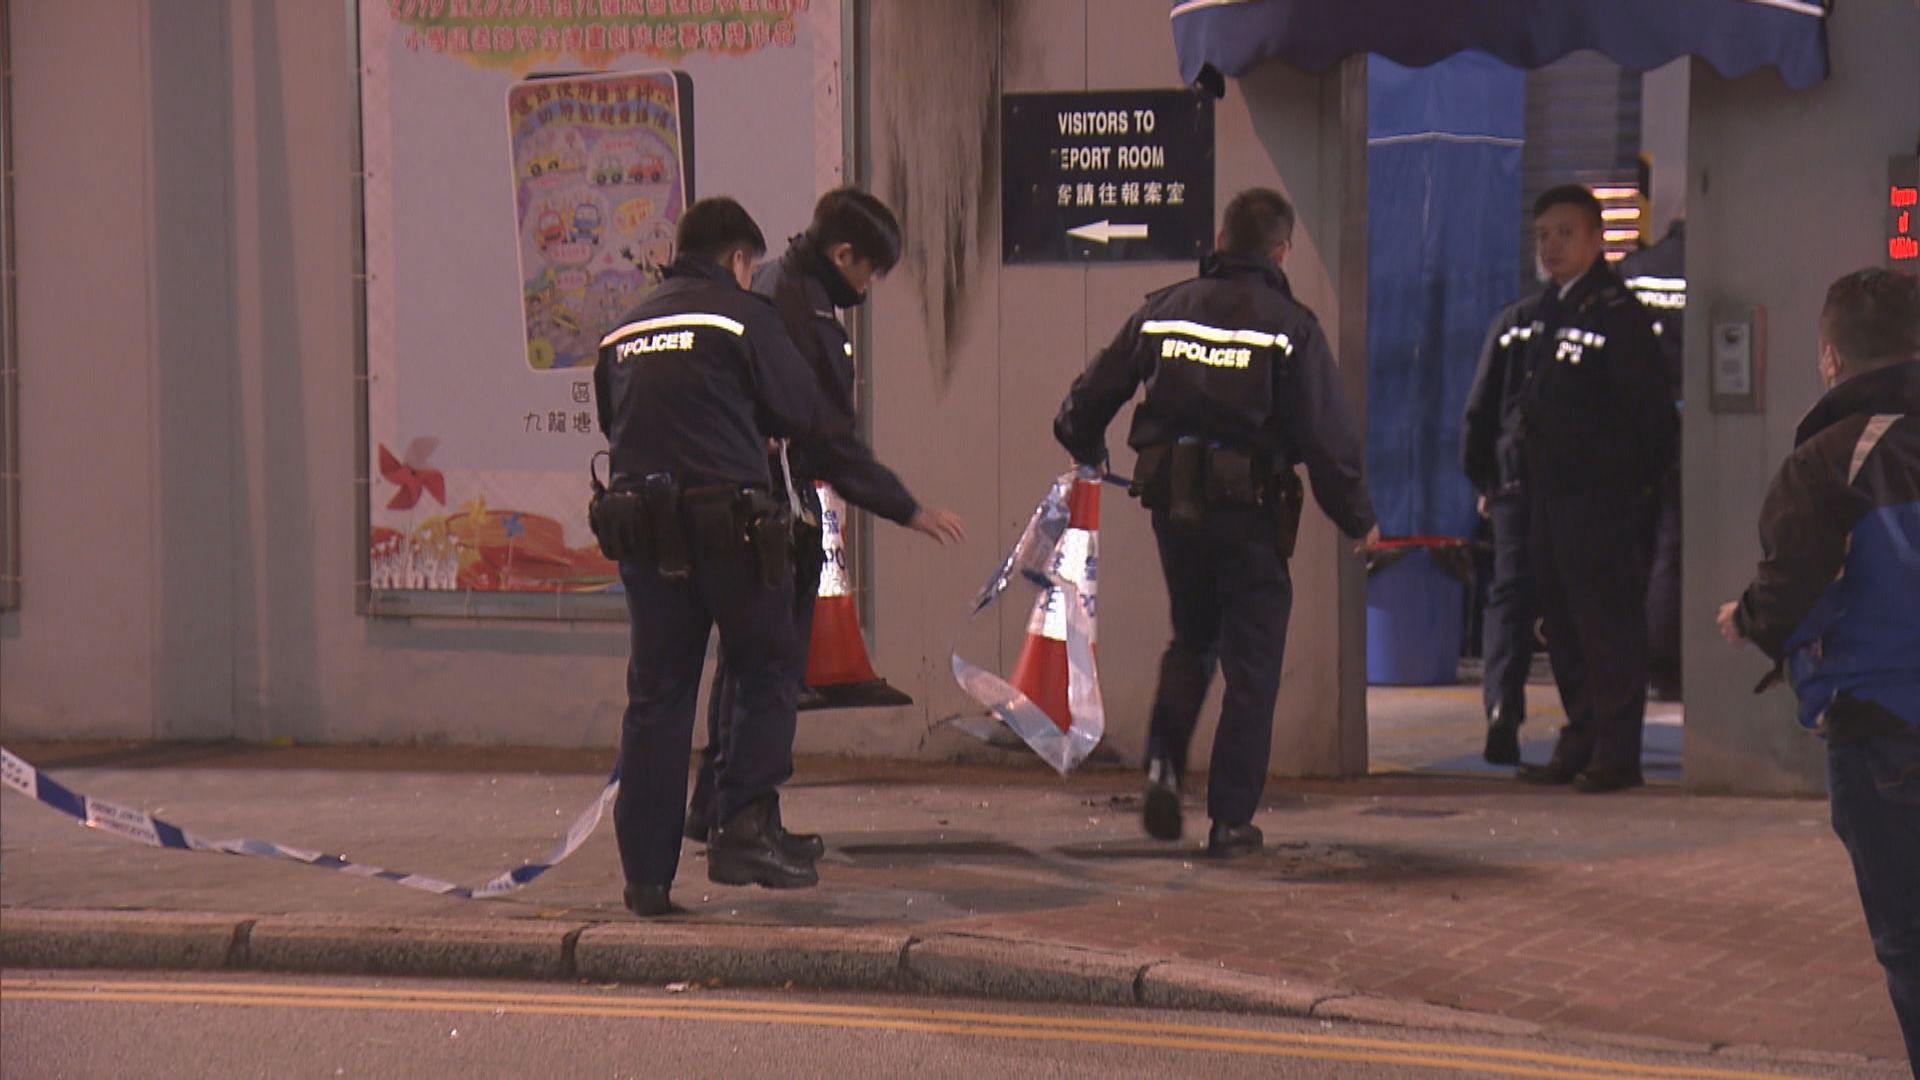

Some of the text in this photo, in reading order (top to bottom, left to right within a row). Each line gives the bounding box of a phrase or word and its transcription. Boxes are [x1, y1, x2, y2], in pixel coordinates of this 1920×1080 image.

[1058, 109, 1155, 135] VISITORS TO
[1051, 145, 1165, 171] EPORT ROOM
